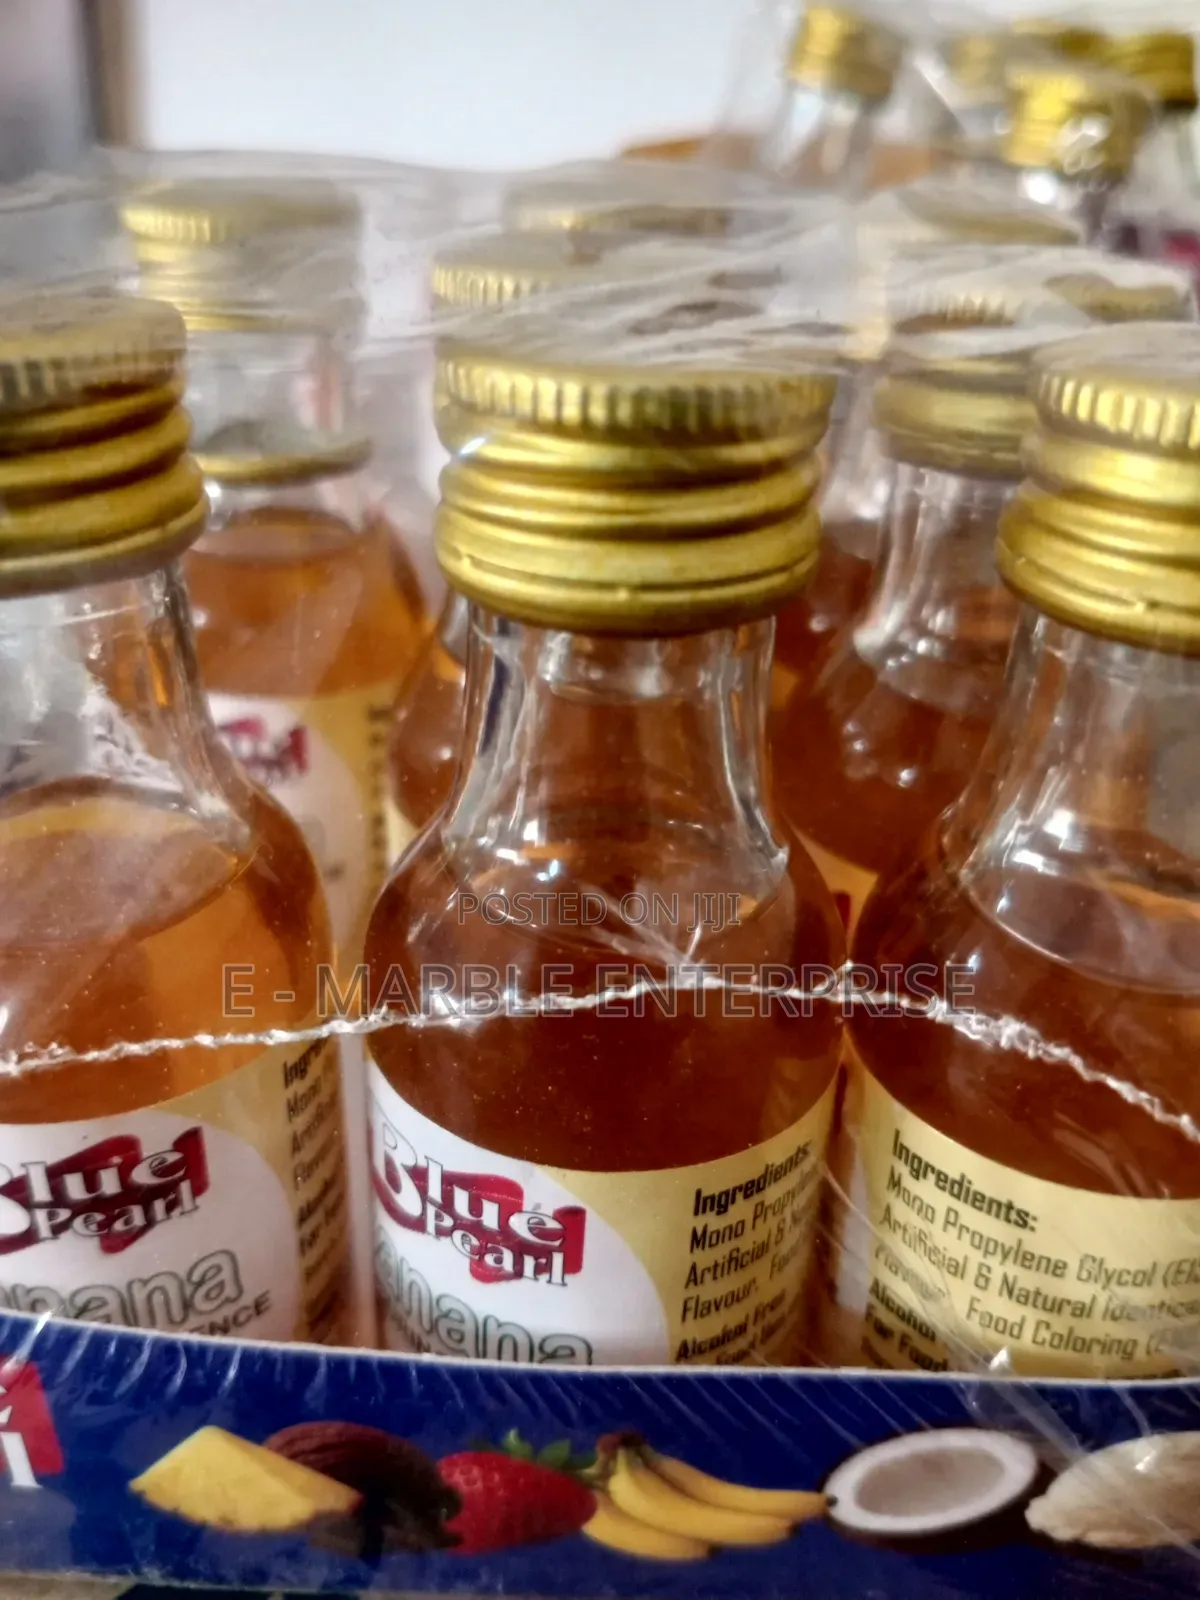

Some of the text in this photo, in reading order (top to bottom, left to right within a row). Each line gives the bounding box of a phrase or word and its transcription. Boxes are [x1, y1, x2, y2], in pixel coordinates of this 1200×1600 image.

[368, 1096, 567, 1248] Blue
[892, 1128, 1038, 1232] Ingredients:
[35, 1178, 200, 1241] Pearl
[690, 1218, 745, 1254] Mono
[887, 1163, 936, 1225] Mono
[942, 1205, 1069, 1279] Propylene
[1075, 1252, 1157, 1291] Glycol
[425, 1200, 568, 1288] Pearl
[684, 1227, 771, 1290] Artificial
[965, 1294, 1026, 1341] Food
[1031, 1318, 1139, 1361] Coloring
[998, 1271, 1097, 1319] Natural
